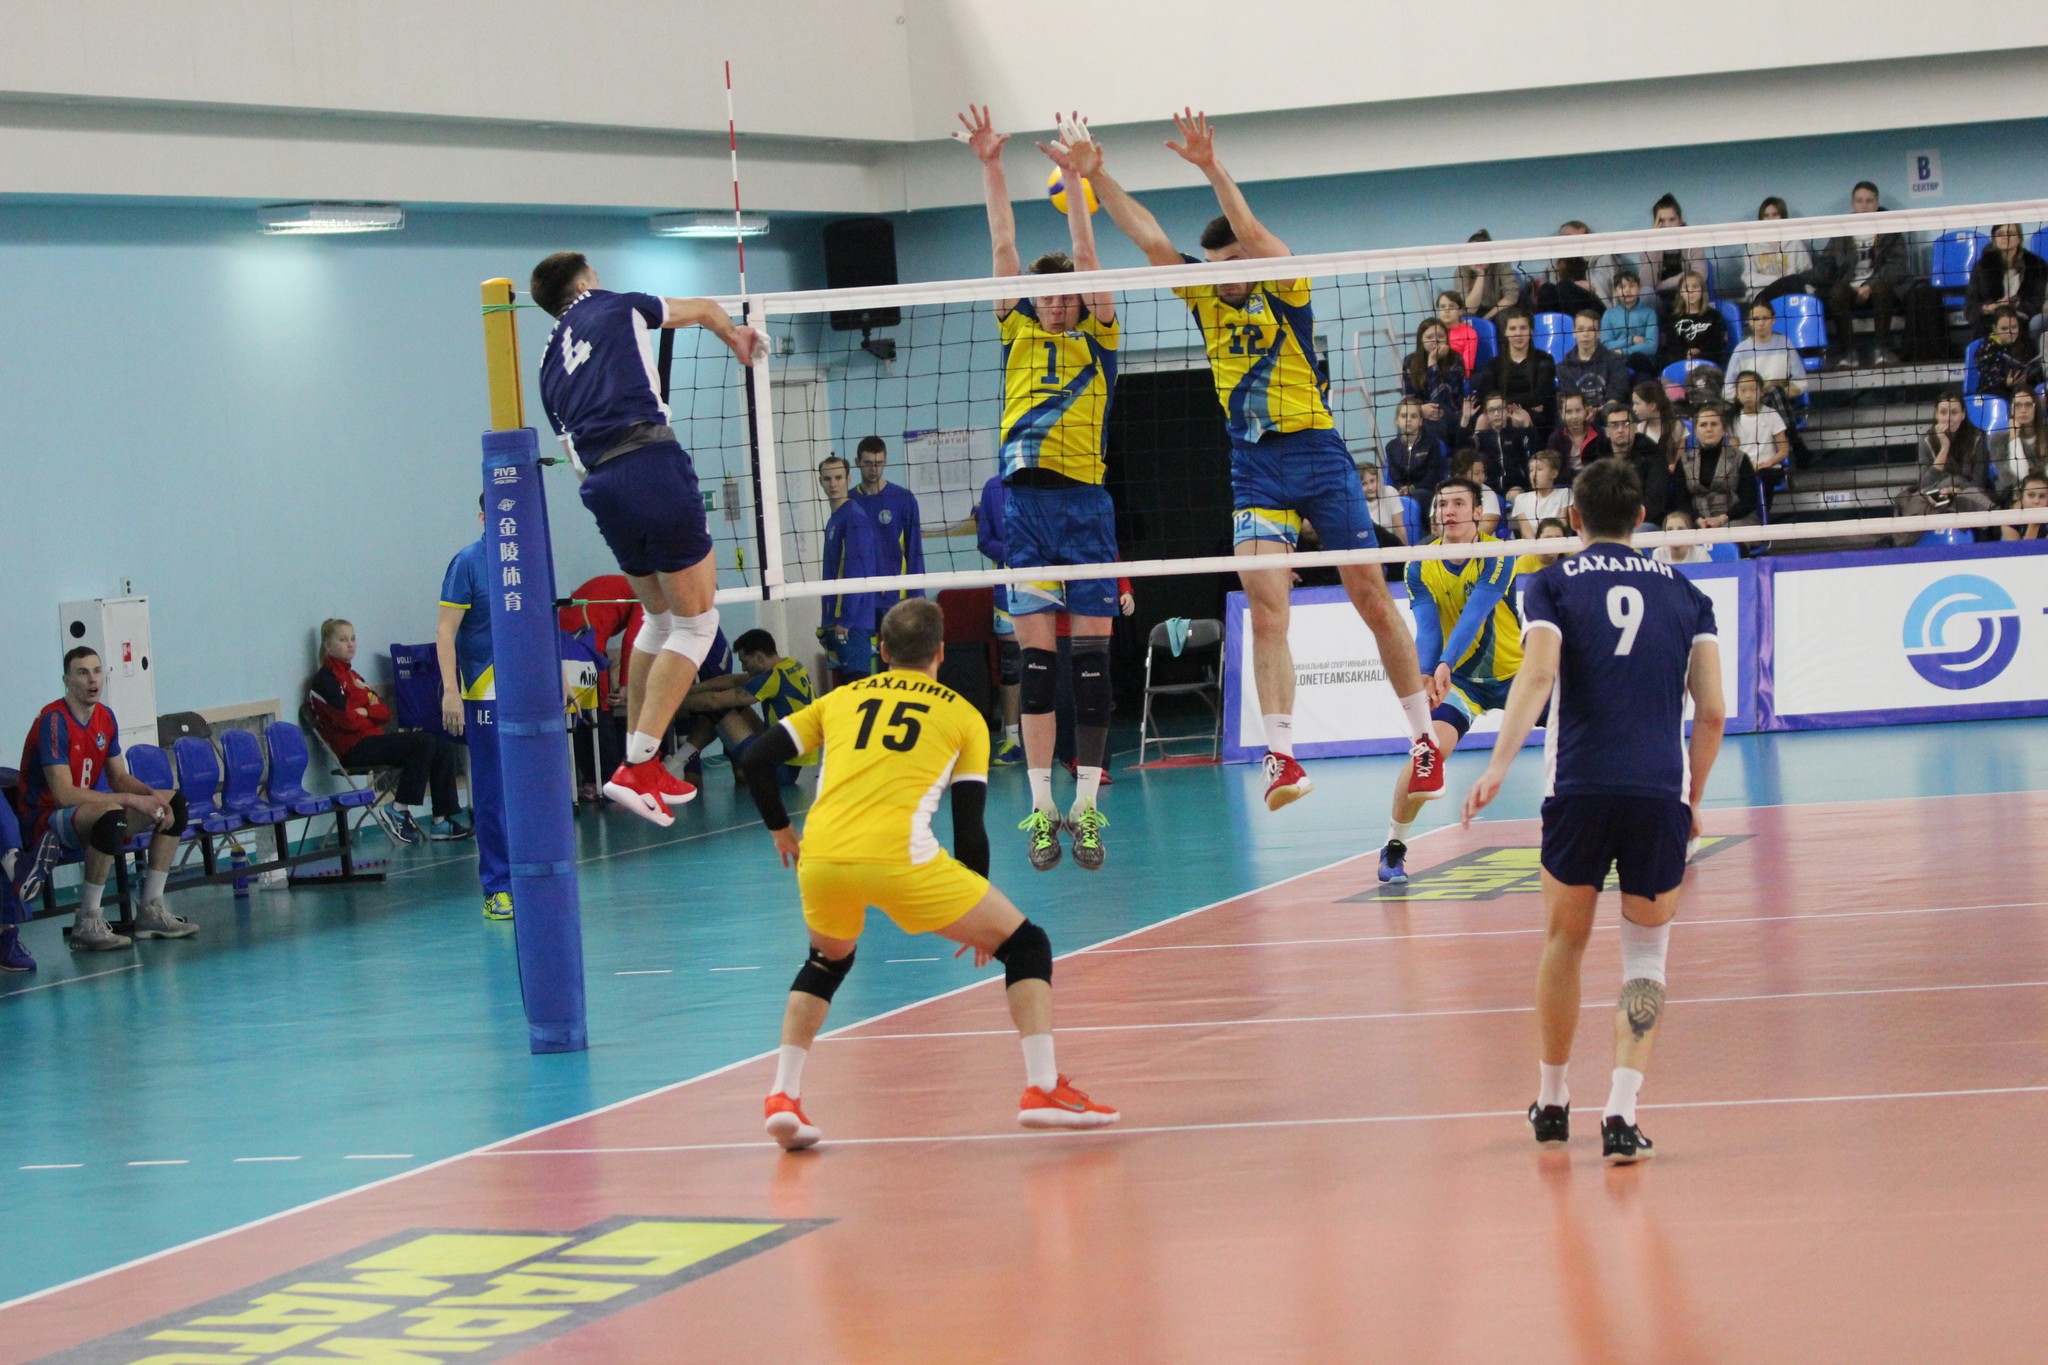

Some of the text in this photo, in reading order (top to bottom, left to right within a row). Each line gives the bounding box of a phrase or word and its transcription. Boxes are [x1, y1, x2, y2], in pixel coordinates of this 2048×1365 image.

[562, 326, 592, 375] 4
[1225, 323, 1267, 354] 12
[1041, 341, 1059, 384] 1
[494, 467, 517, 477] FIVB
[1235, 511, 1251, 534] 12
[499, 517, 522, 611] 金陵体育
[1562, 555, 1674, 580] САХАЛИН
[1606, 585, 1645, 656] 9
[1295, 669, 1389, 686] .ONETEAMSAKHALI
[854, 698, 931, 752] 15
